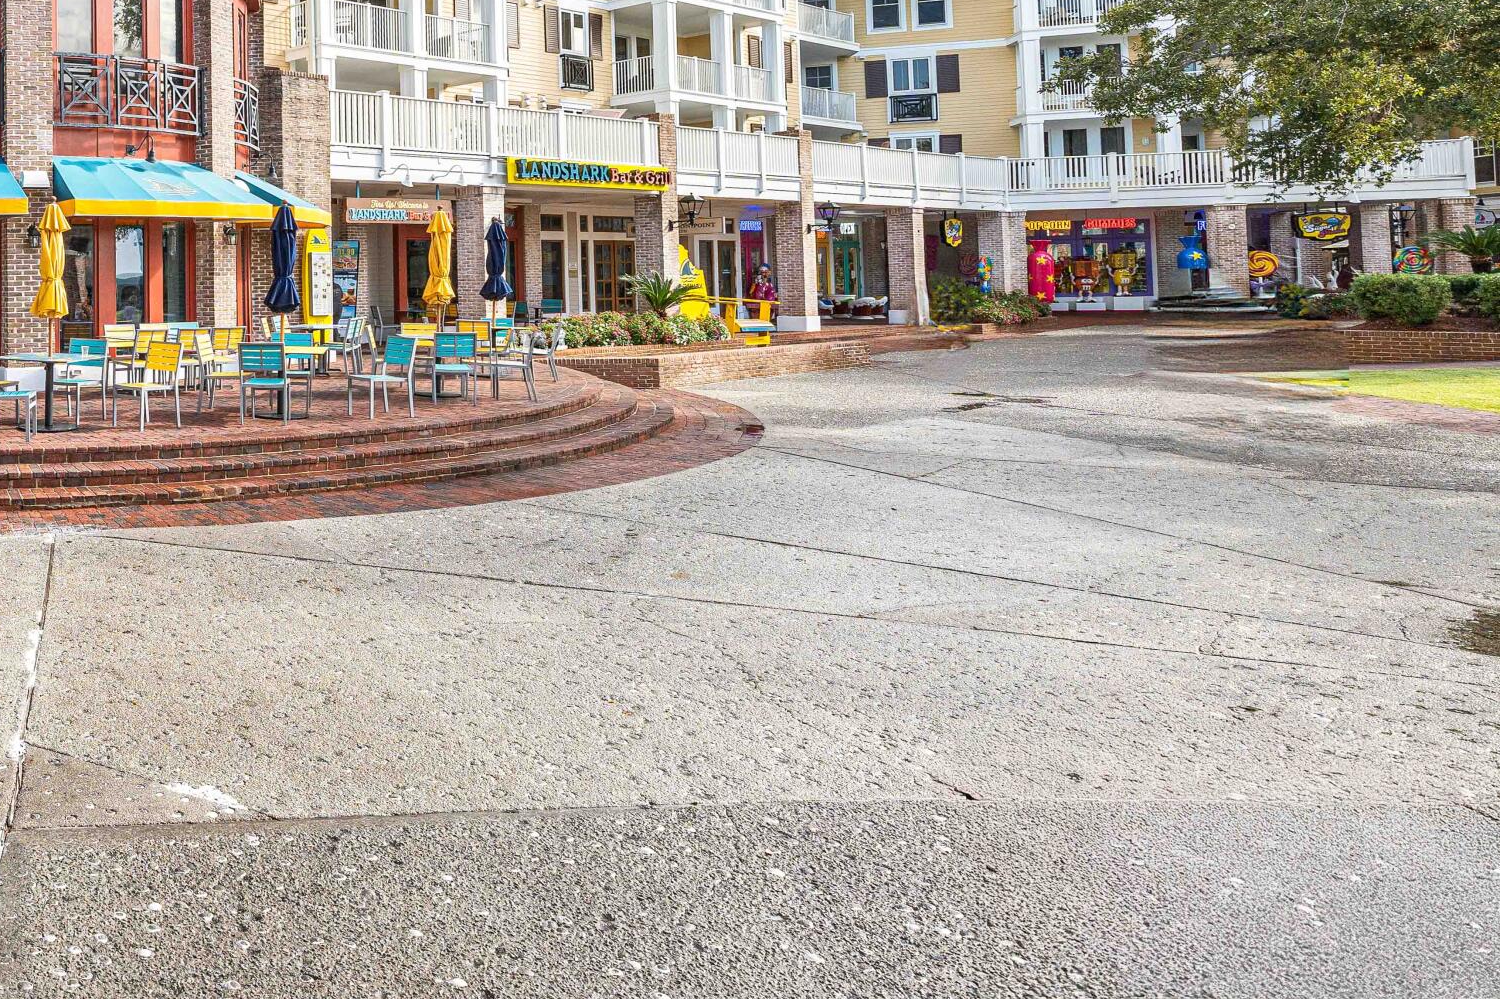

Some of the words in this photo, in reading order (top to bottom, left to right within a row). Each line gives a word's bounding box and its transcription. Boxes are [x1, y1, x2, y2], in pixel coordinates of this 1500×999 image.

[519, 158, 610, 182] LANDSHARK
[610, 168, 633, 183] Bar
[634, 170, 644, 184] &
[645, 170, 673, 185] Grill
[397, 200, 422, 209] Welcome
[348, 208, 407, 220] LANDSHARK
[407, 210, 423, 220] Bar
[1084, 217, 1137, 230] GUMMIES
